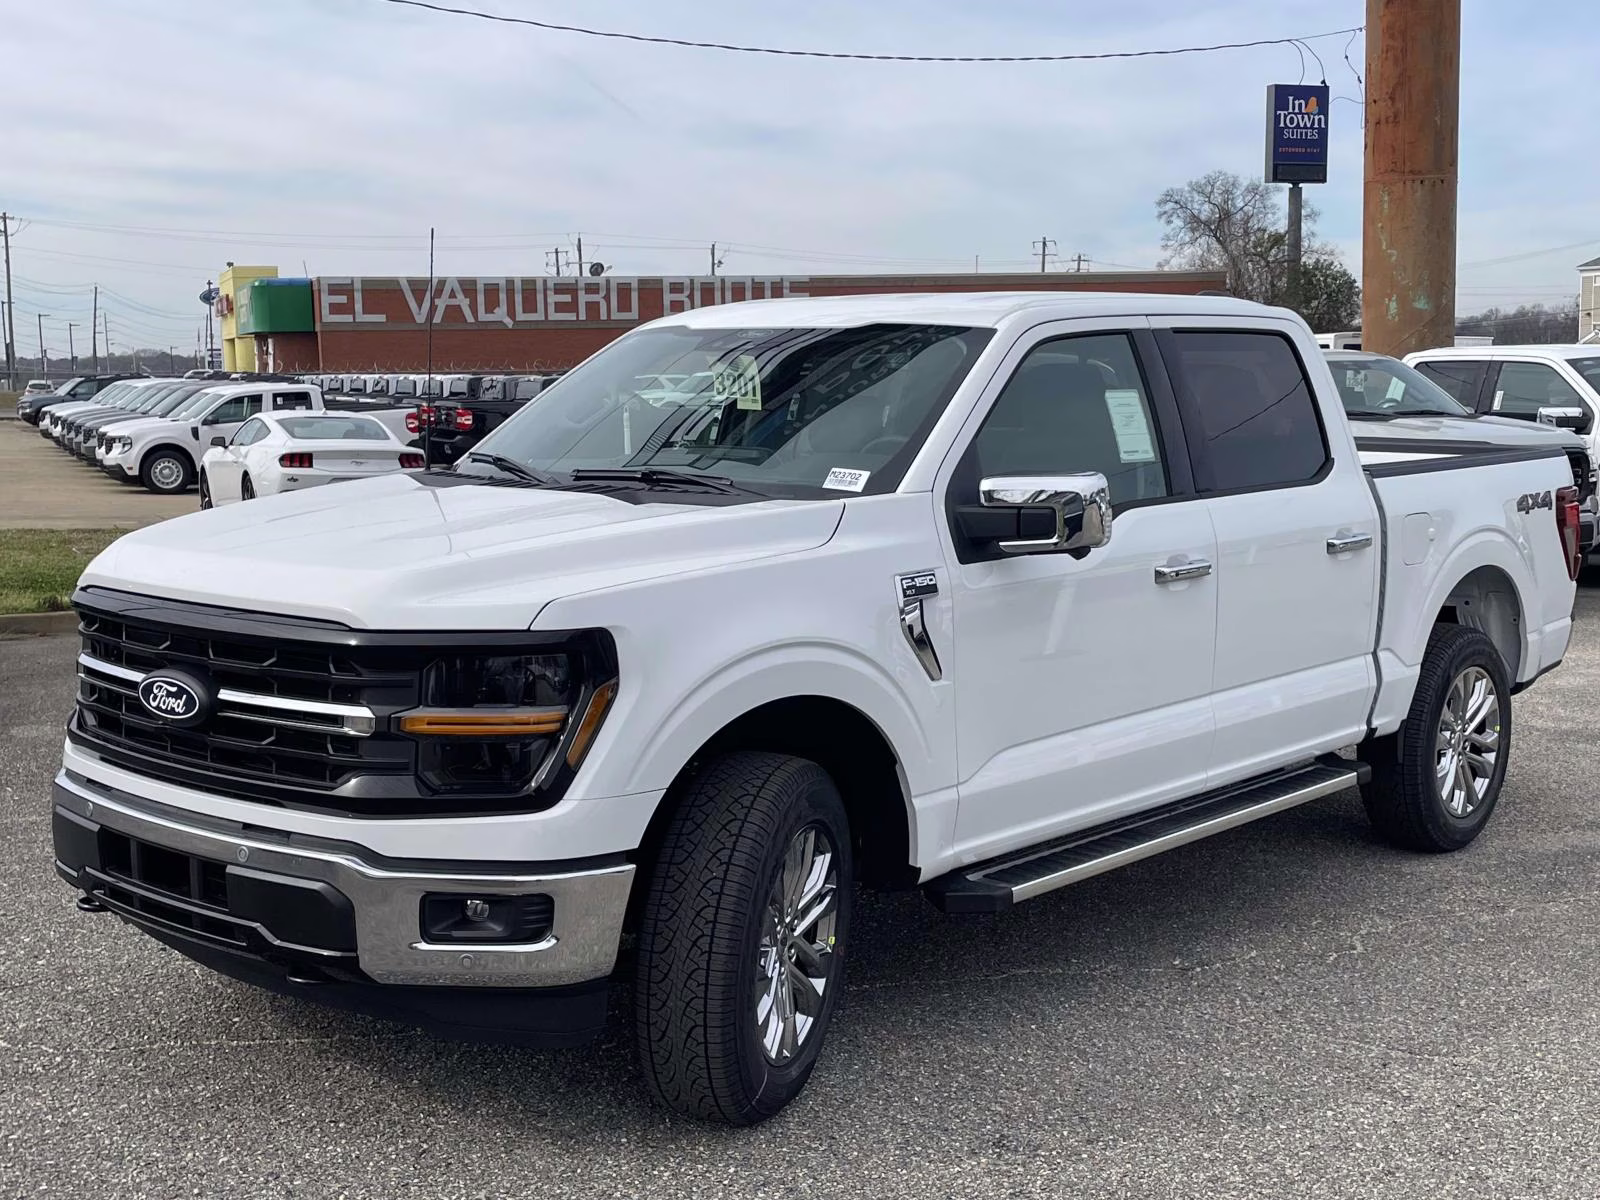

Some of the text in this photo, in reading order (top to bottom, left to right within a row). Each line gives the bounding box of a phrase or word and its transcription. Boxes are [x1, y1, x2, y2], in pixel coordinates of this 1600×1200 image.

[1288, 96, 1306, 113] In
[1277, 111, 1325, 128] Town
[1283, 129, 1319, 139] SUITES
[319, 276, 387, 323] EL
[398, 275, 639, 329] VAQUERO
[902, 575, 936, 589] F-150
[149, 681, 187, 714] Ford
